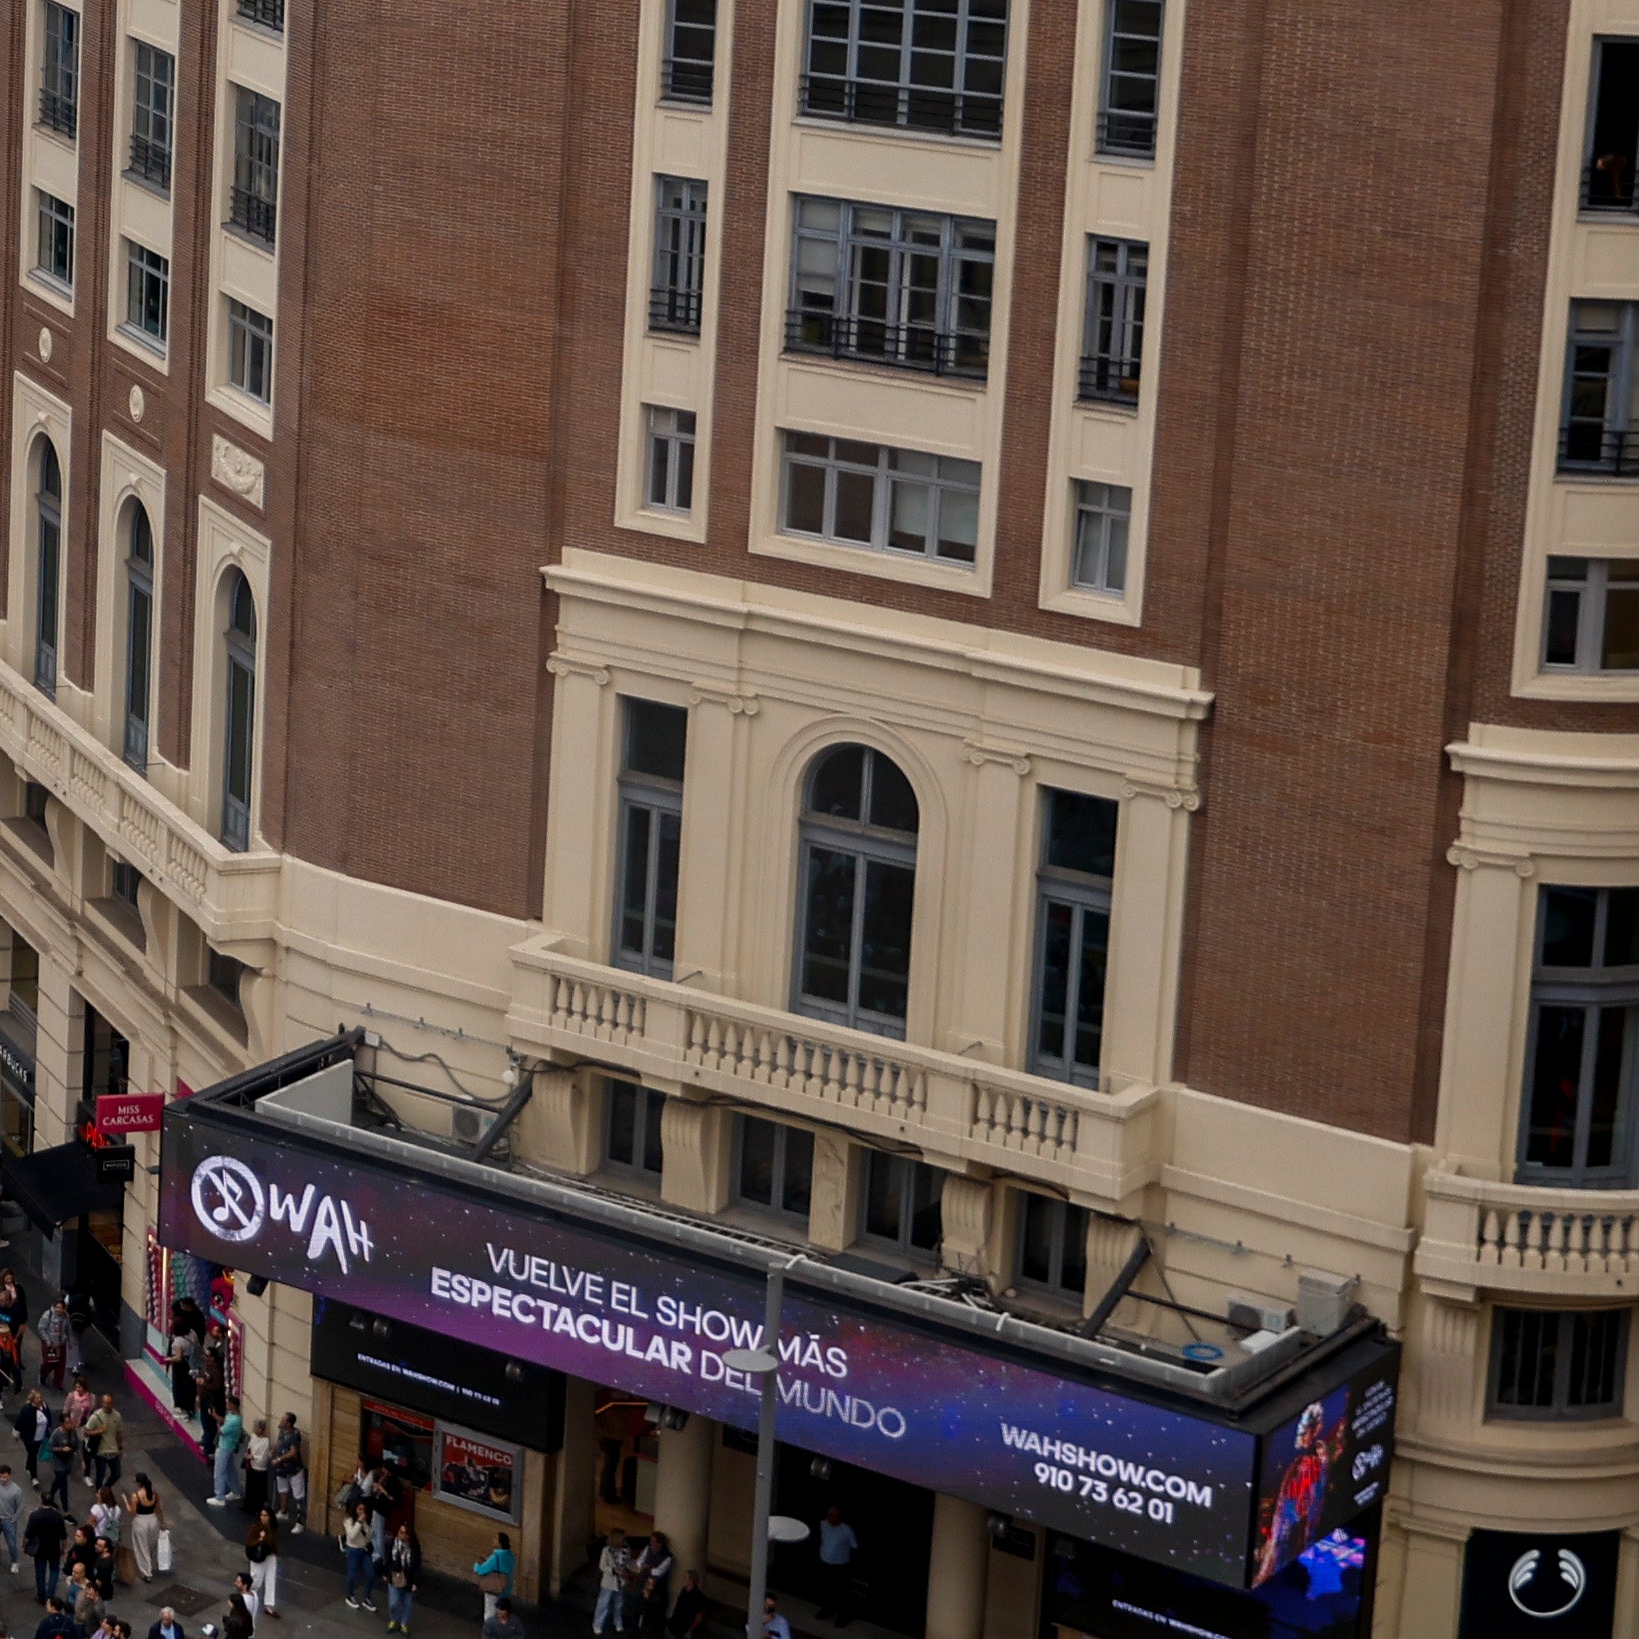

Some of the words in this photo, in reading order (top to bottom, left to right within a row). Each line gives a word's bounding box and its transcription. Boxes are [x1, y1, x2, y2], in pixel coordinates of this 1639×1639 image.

[102, 1114, 154, 1126] CARCASAS
[117, 1104, 140, 1115] MISS
[269, 1183, 374, 1275] WAH
[486, 1242, 605, 1307] VUELVE
[610, 1280, 649, 1321] EL
[655, 1295, 765, 1352] SHOW
[357, 1352, 391, 1371] ENTRADAS
[391, 1362, 401, 1374] EN
[431, 1265, 693, 1375] ESPECTACULAR
[700, 1350, 763, 1396] DEL
[776, 1372, 907, 1439] MUNDO
[446, 1434, 513, 1466] FLAMENCO
[999, 1422, 1213, 1509] WAHSHOW.COM
[1033, 1462, 1074, 1492] 910
[1077, 1474, 1109, 1503] 73
[1111, 1487, 1144, 1515] 62
[1147, 1497, 1174, 1524] 01
[1112, 1598, 1154, 1622] ENTRADAS
[1154, 1611, 1167, 1625] EN
